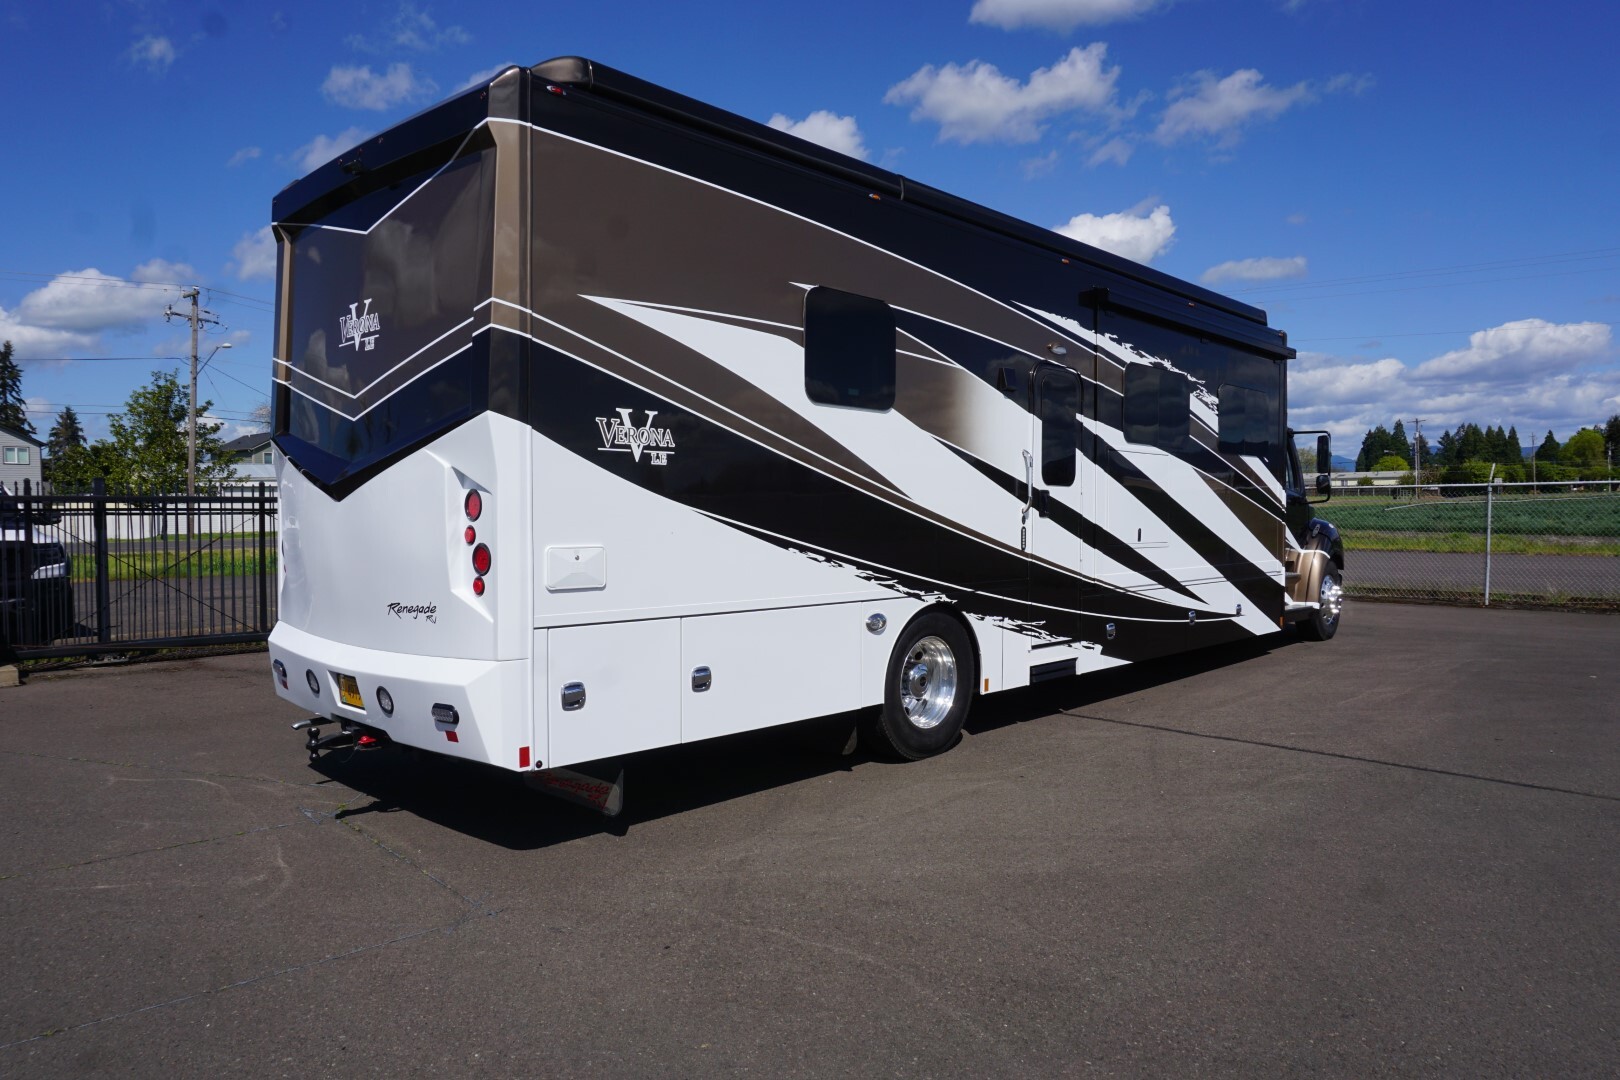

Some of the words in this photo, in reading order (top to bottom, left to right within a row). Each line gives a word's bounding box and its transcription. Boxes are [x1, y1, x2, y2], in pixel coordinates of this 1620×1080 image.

[340, 312, 380, 343] VERONA
[595, 417, 675, 448] VERONA
[651, 452, 667, 465] LE
[387, 601, 437, 620] Renegade
